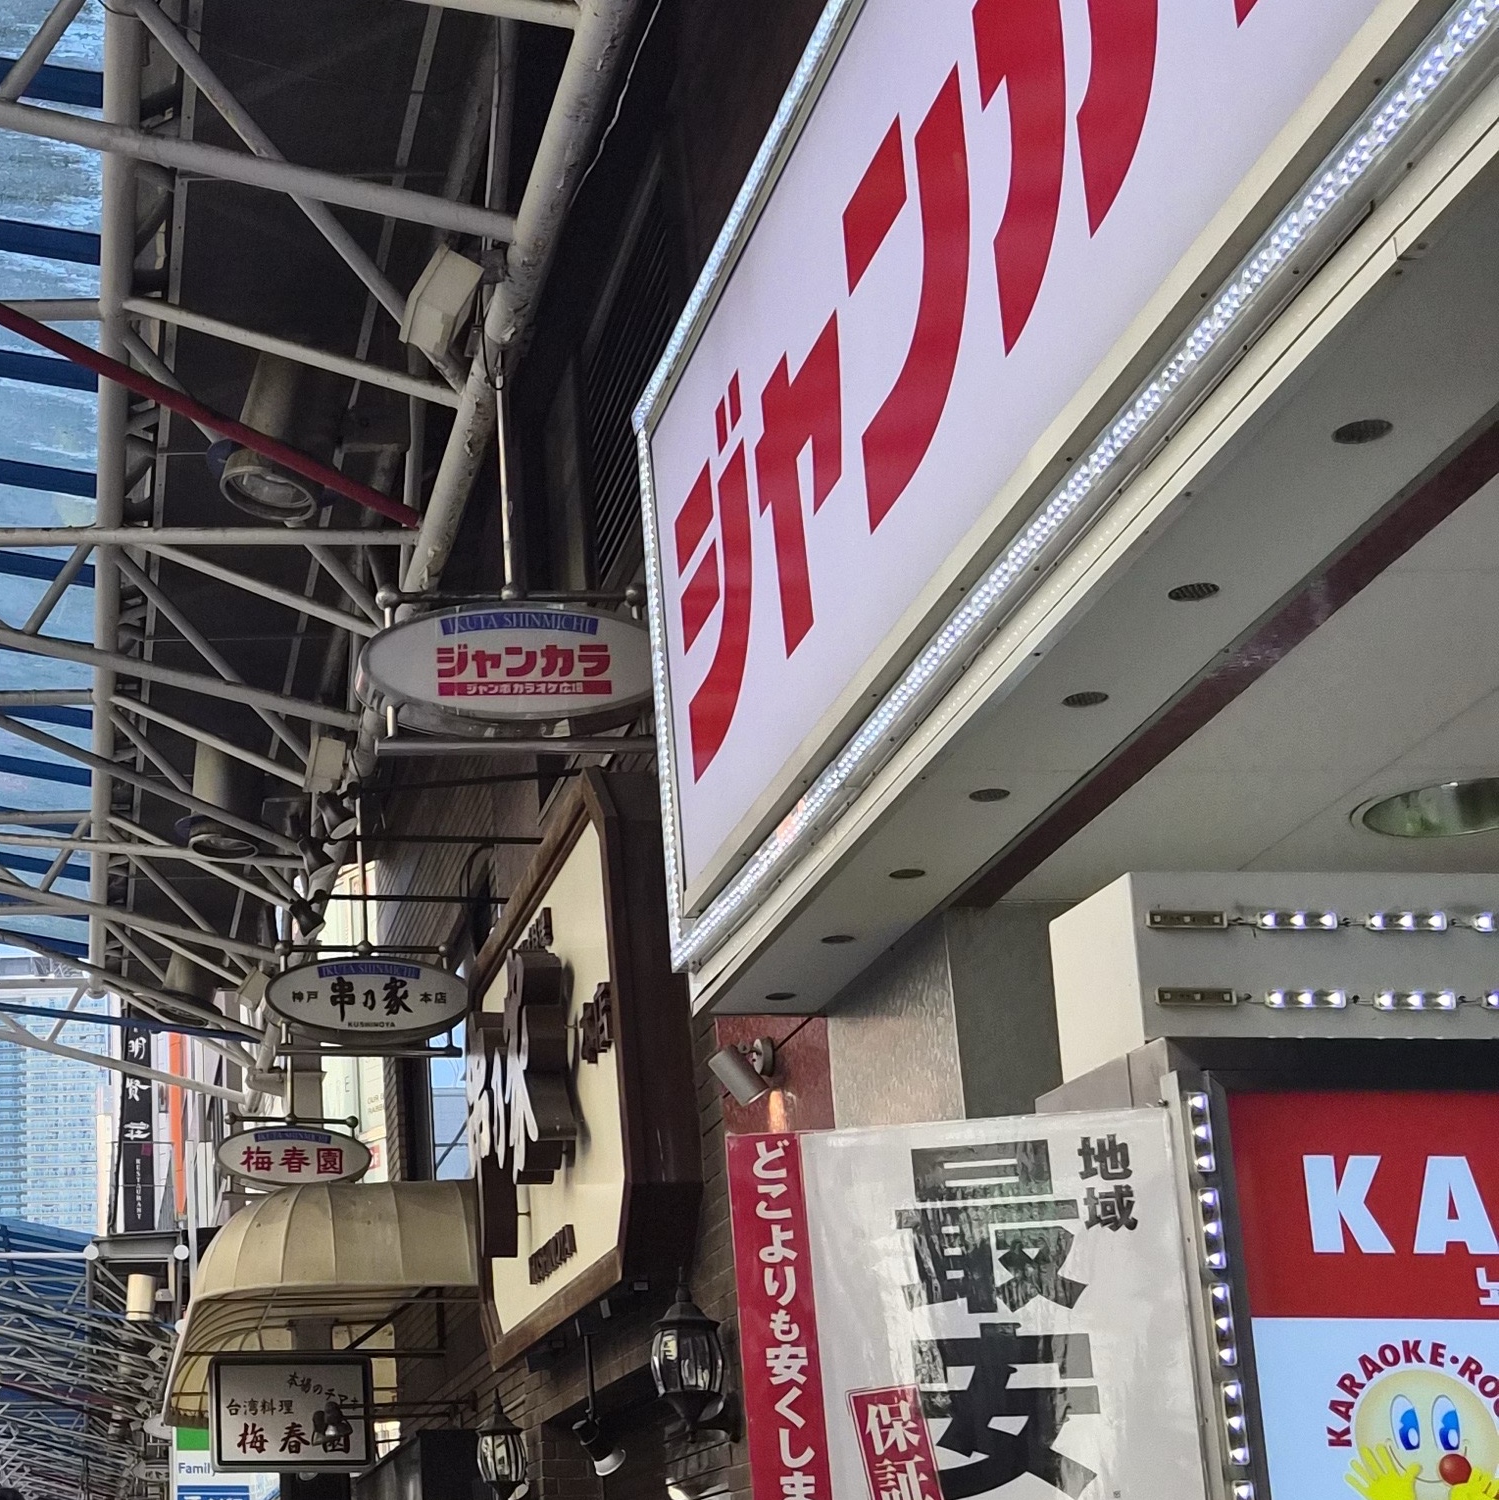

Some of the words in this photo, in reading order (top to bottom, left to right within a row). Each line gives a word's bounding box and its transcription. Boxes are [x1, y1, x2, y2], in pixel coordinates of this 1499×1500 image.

[448, 614, 500, 632] IKUTA
[501, 613, 590, 632] SHINMICHI
[437, 644, 611, 678] ジャンカラ
[466, 682, 584, 695] ジャンボカラオケ広場
[292, 990, 318, 1003] 神戸
[330, 976, 413, 1022] 串乃家
[420, 992, 447, 1004] 本店
[240, 1146, 343, 1175] 梅春園
[1077, 1134, 1138, 1233] 地域
[895, 1140, 1101, 1500] 最安
[226, 1398, 294, 1416] 台湾料理
[178, 1463, 216, 1476] Famil
